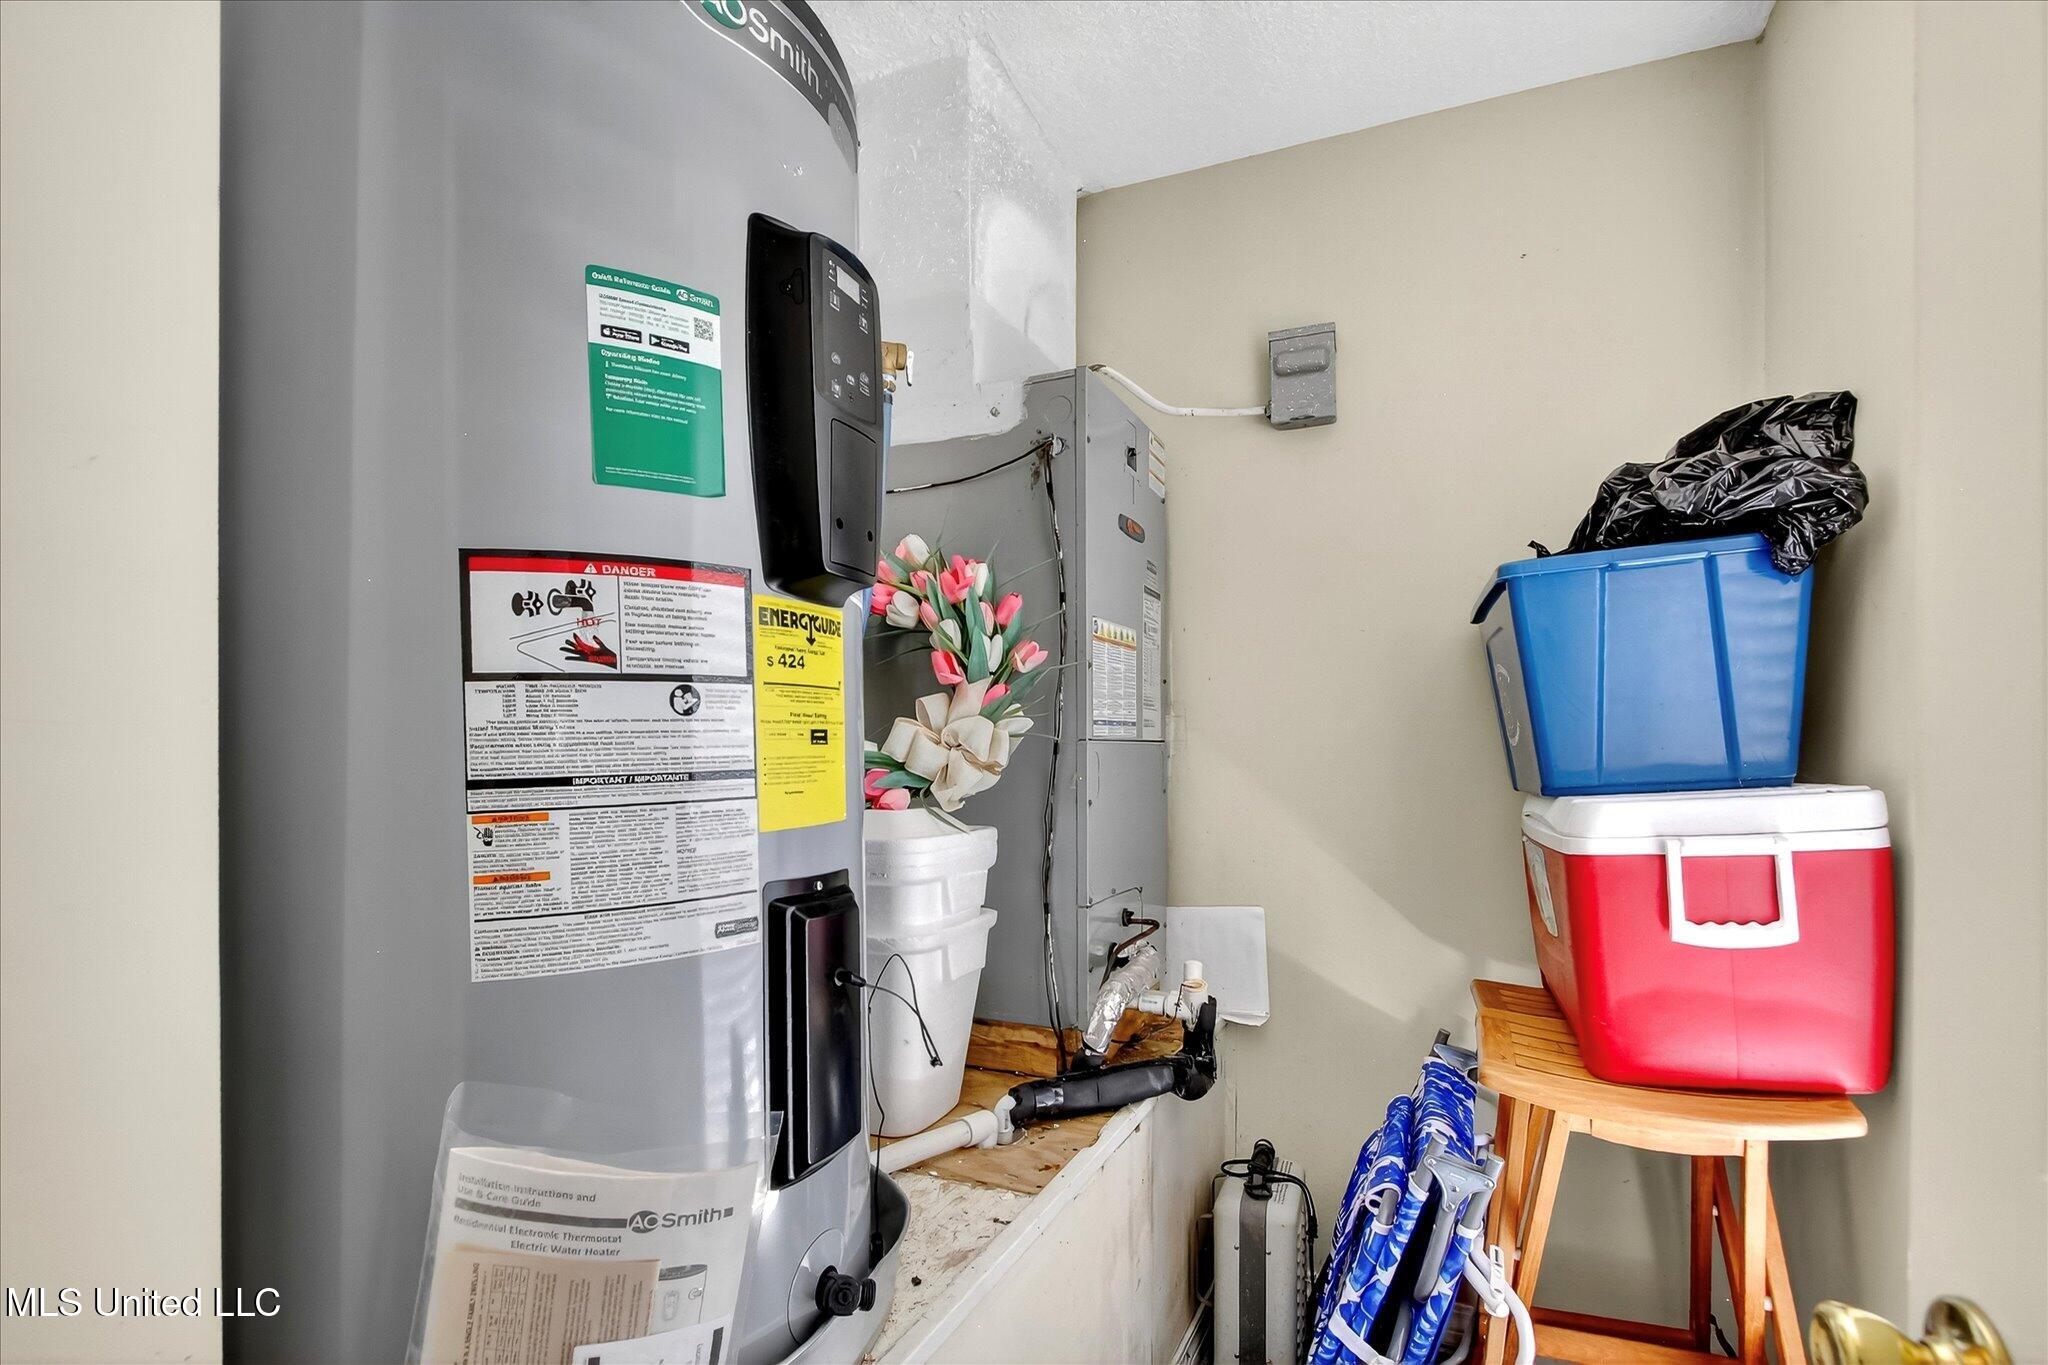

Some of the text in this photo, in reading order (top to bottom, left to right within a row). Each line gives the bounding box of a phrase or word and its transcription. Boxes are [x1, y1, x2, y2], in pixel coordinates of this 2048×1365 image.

[749, 8, 820, 95] Smith
[602, 565, 656, 577] DANGER
[778, 653, 805, 669] 424
[486, 1191, 507, 1202] Care
[511, 1195, 541, 1208] Guide
[576, 1193, 596, 1203] and
[661, 1208, 721, 1228] Smith
[563, 1232, 622, 1244] Thermostat
[510, 1239, 620, 1257] Electric Water Heater
